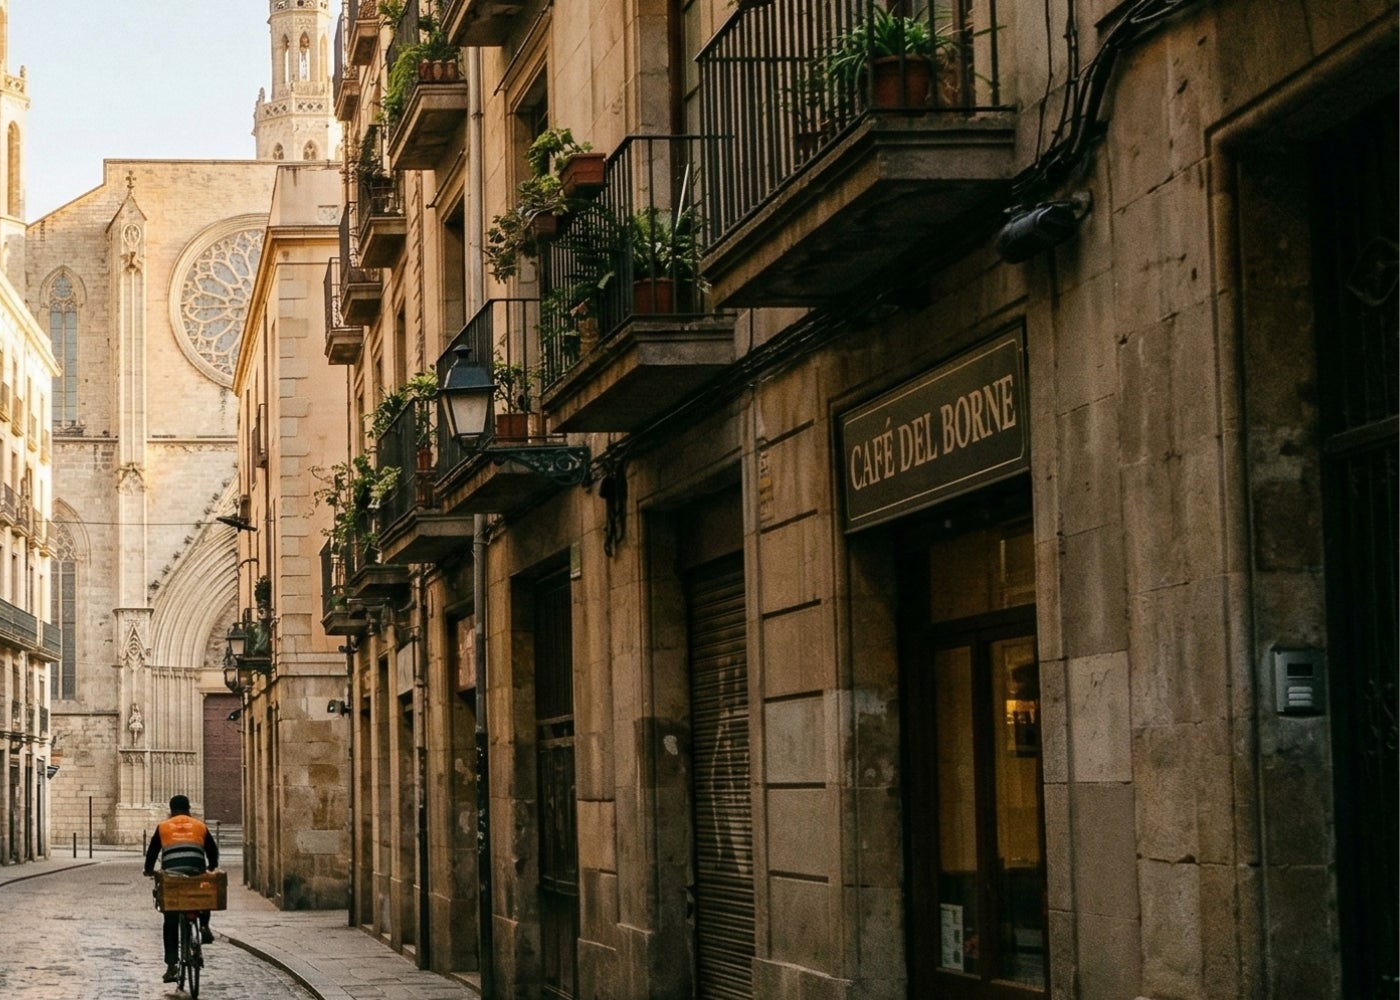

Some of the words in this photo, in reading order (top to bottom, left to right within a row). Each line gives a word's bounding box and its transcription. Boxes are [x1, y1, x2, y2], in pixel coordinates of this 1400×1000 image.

[850, 417, 895, 491] CAFÉ
[897, 412, 938, 473] DEL
[940, 373, 1017, 455] BORNE
